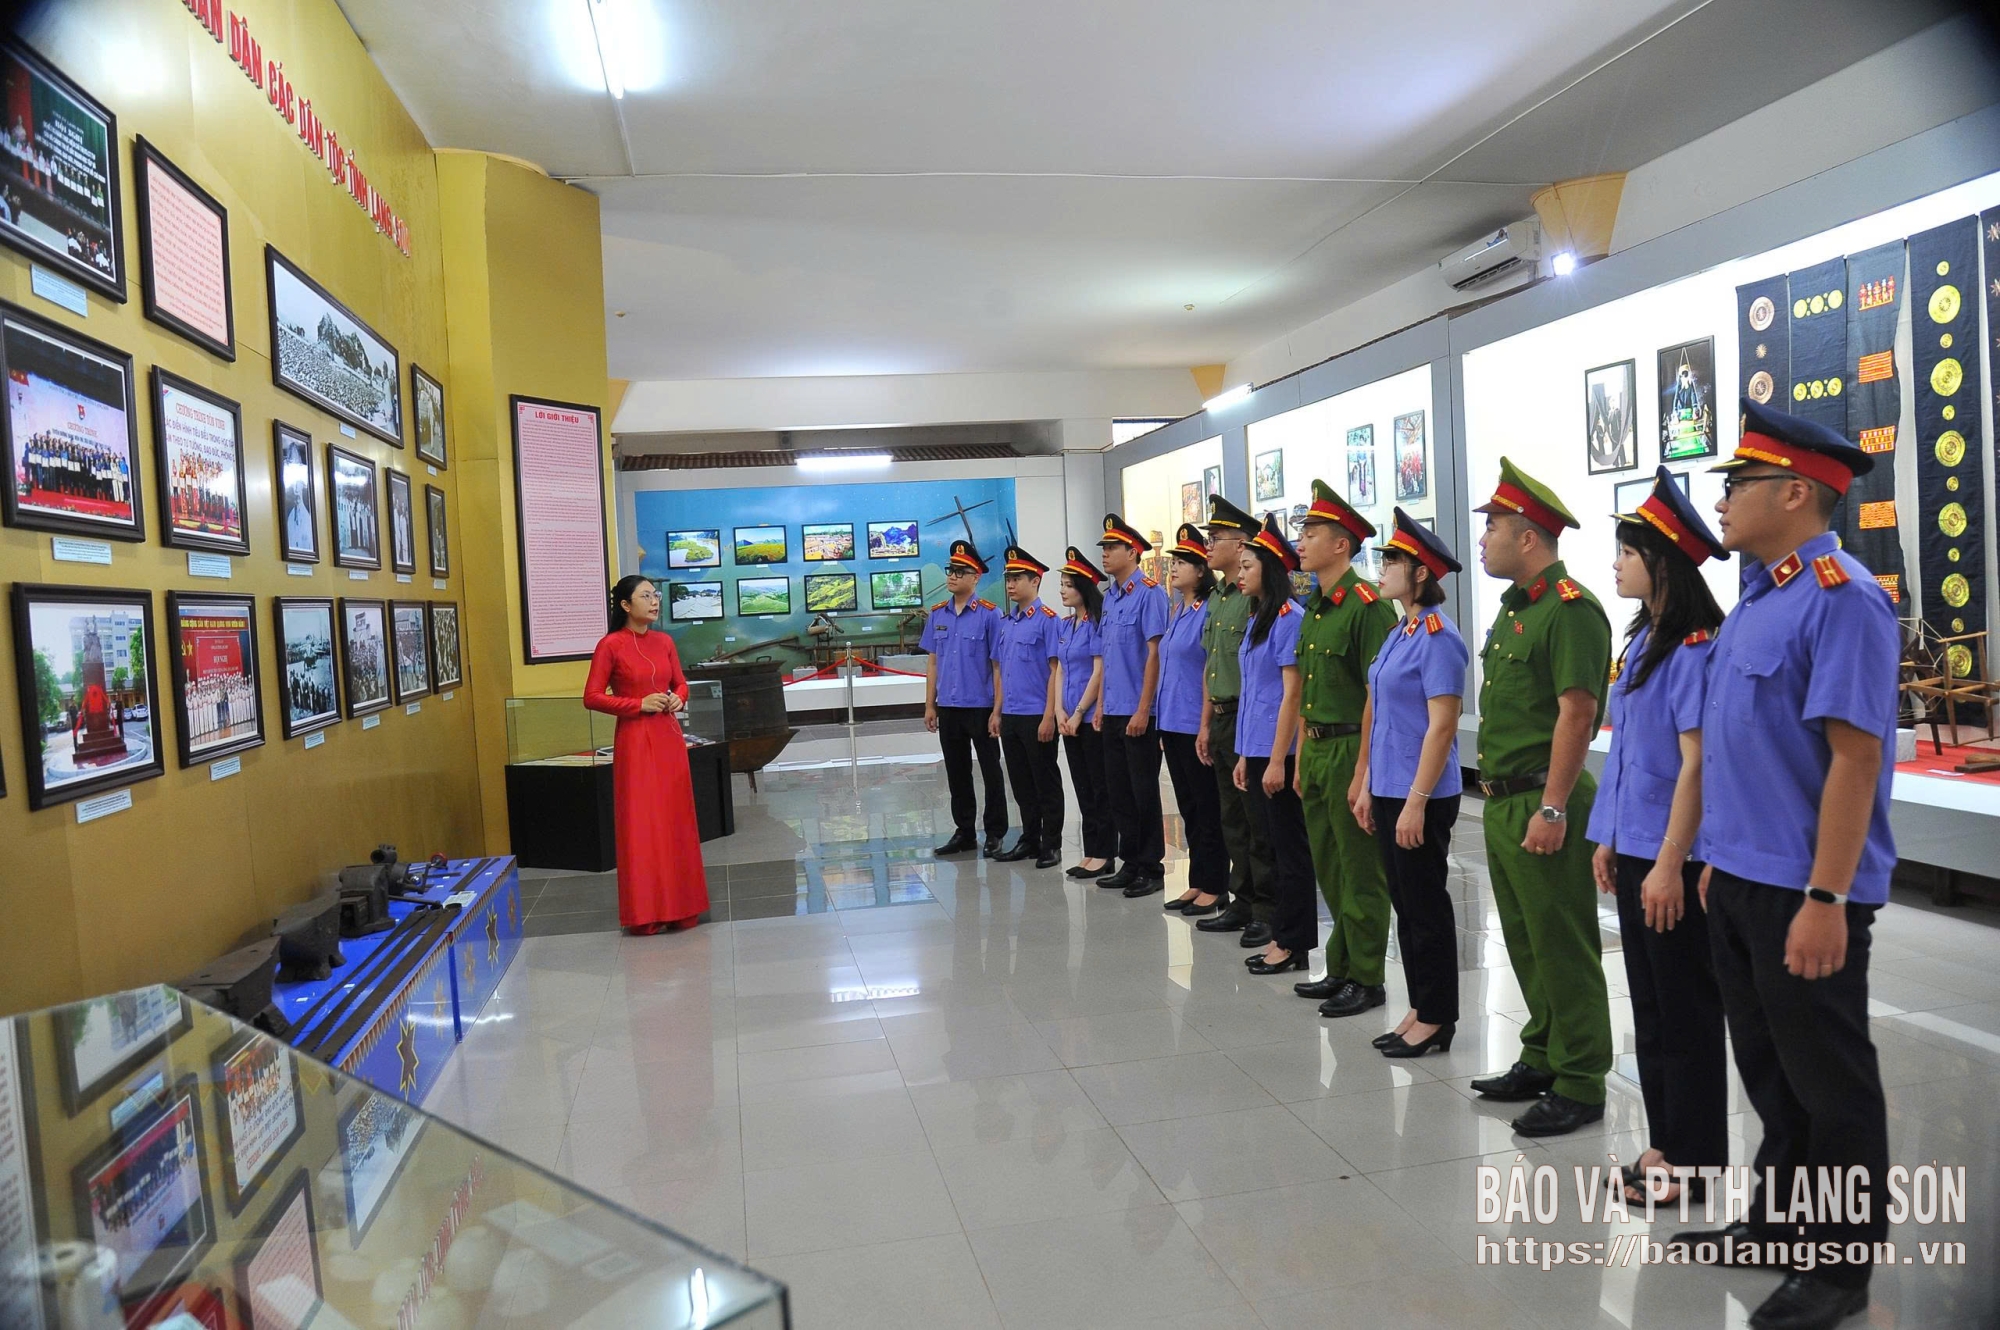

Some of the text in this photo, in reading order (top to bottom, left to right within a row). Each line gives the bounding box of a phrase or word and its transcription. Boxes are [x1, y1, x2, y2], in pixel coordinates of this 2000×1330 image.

[227, 9, 263, 89] DÂN
[266, 60, 294, 124] CÁC
[296, 95, 324, 160] DÂN
[324, 130, 346, 185] TỘC
[344, 149, 368, 211] TỈNH
[368, 185, 393, 239] LẠNG
